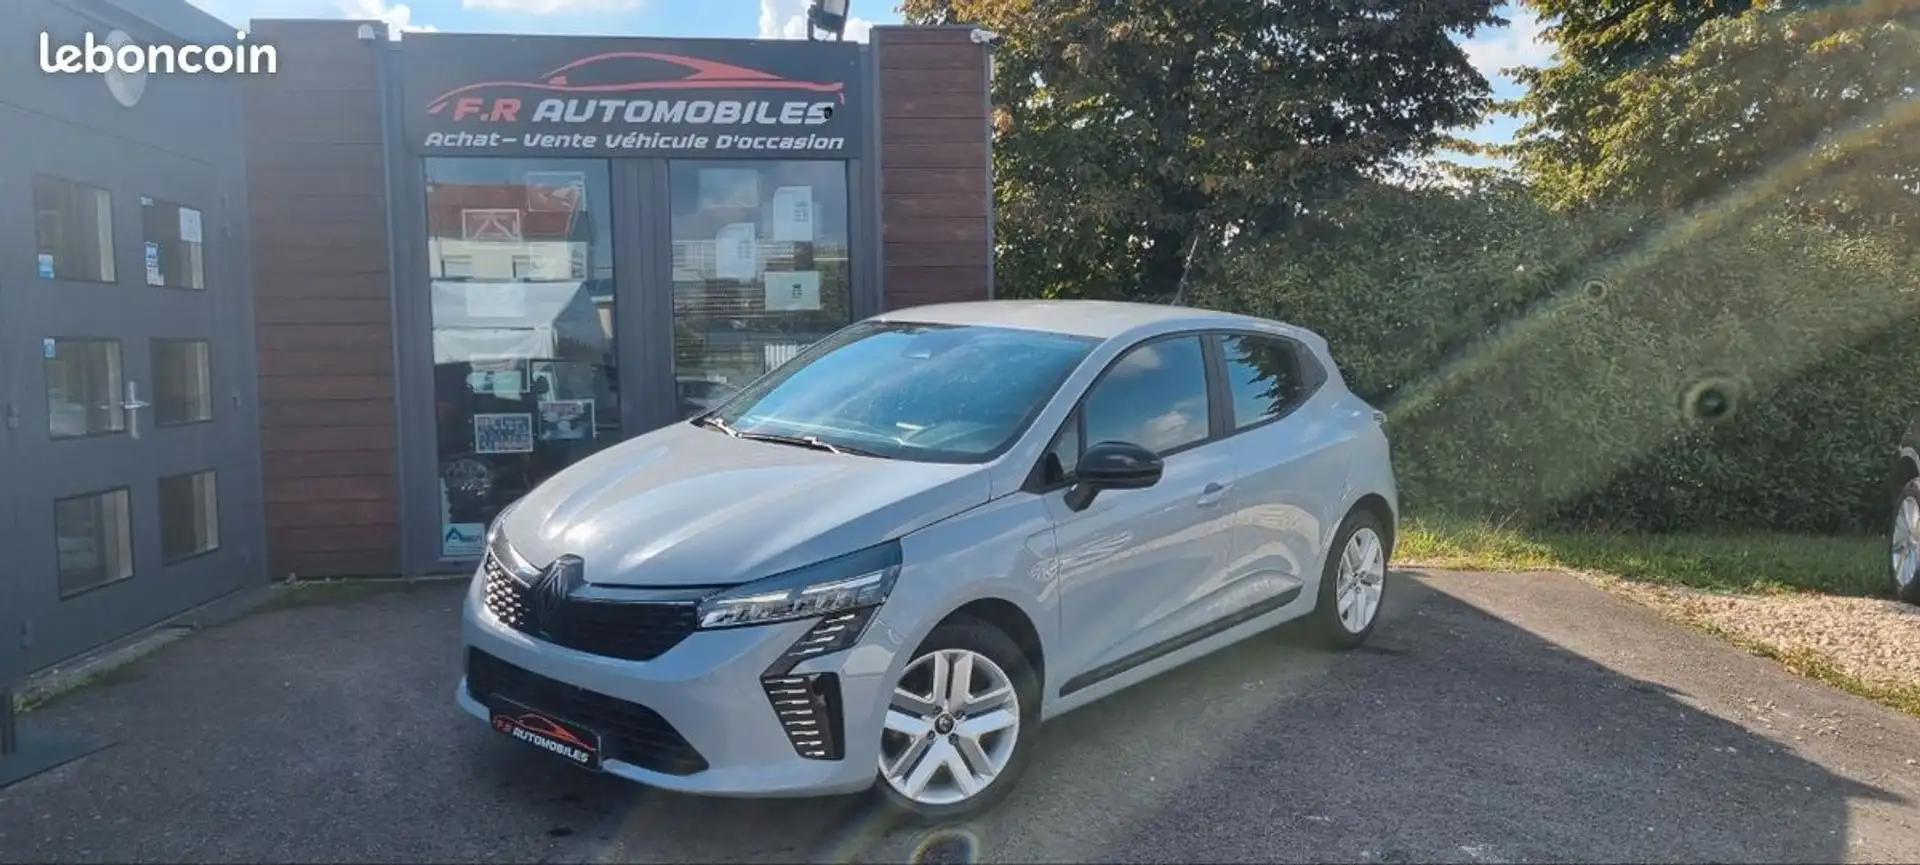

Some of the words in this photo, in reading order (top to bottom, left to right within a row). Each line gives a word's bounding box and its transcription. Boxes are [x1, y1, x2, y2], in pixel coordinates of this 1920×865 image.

[453, 98, 521, 121] F.R
[532, 99, 835, 124] AUTOMOBILES
[523, 133, 597, 148] Vente
[605, 133, 709, 149] Véhicule
[715, 134, 844, 150] D'occasion
[513, 728, 589, 762] AUTOMOBILES
